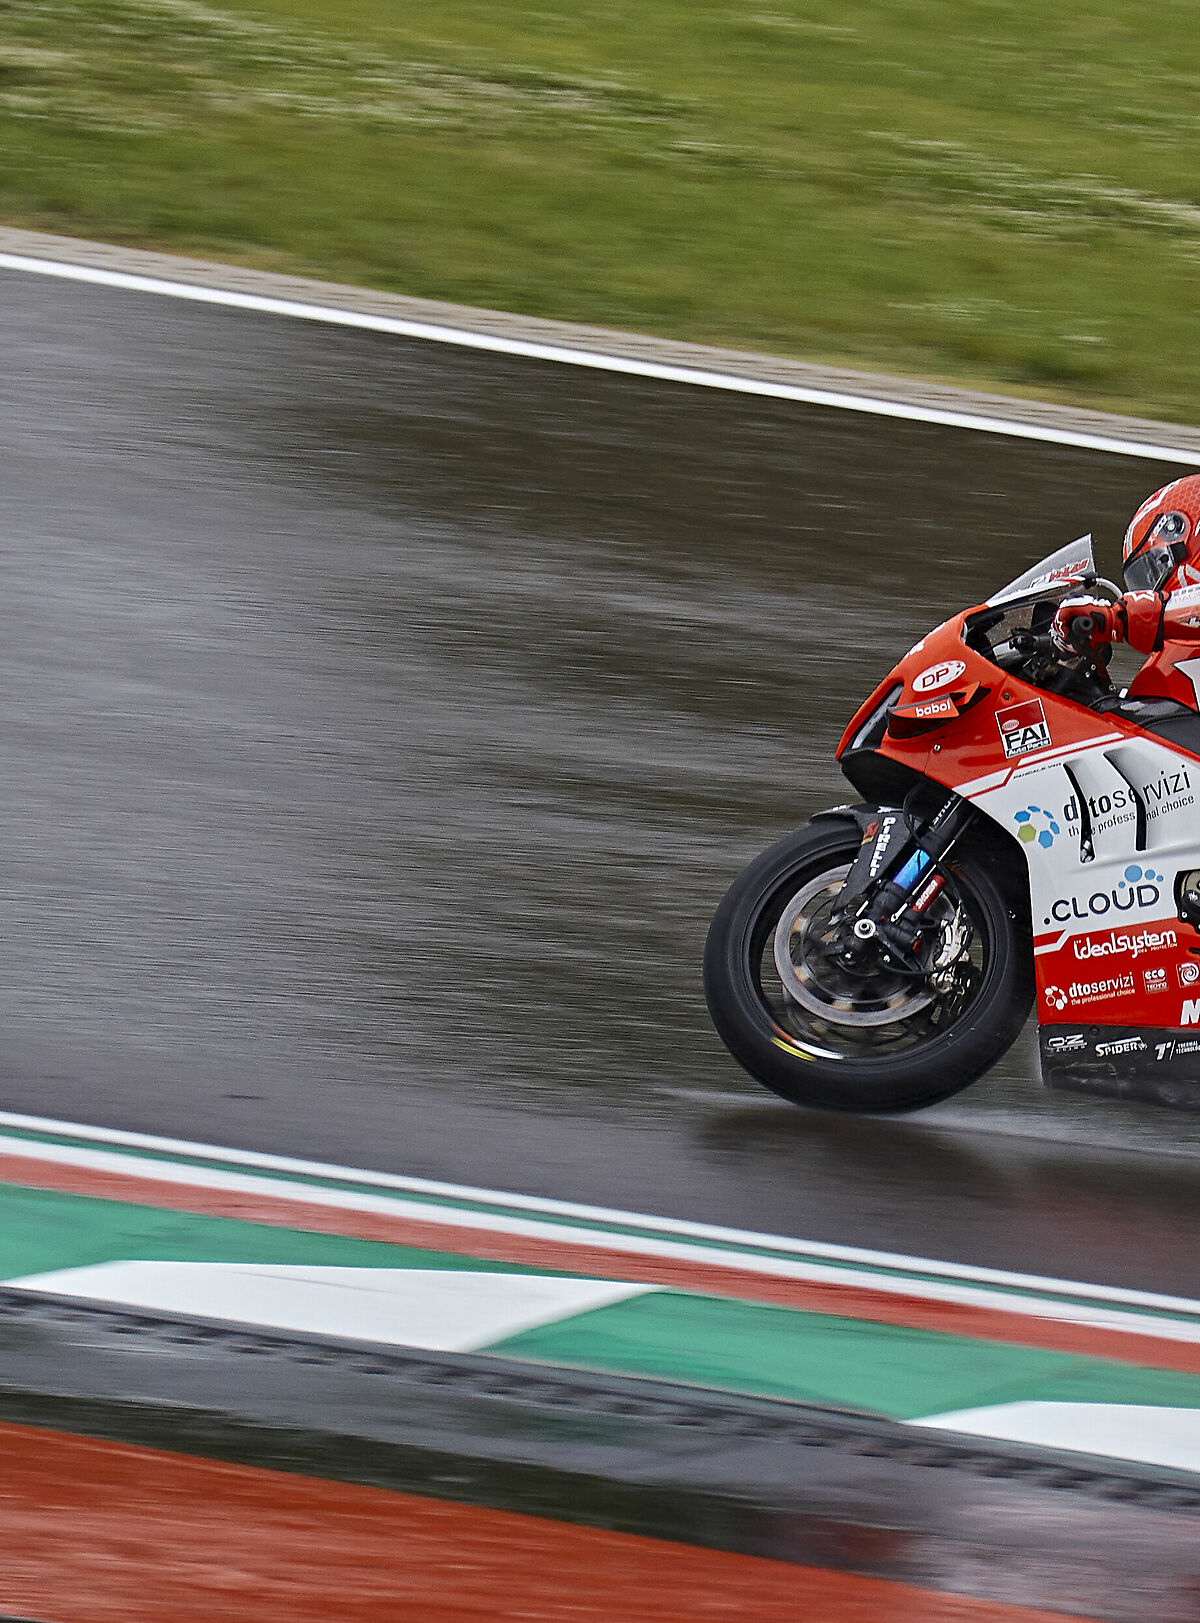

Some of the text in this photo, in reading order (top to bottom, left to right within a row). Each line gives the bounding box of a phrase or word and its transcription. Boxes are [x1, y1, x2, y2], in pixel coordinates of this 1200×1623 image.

[922, 667, 949, 689] DP
[915, 700, 951, 718] babol
[1005, 723, 1047, 749] FAI
[1097, 807, 1160, 836] professnal
[1161, 794, 1195, 815] choice
[869, 816, 896, 877] PIRELLI
[1068, 971, 1134, 998] dtoservizi
[1094, 1036, 1142, 1057] SPIDER
